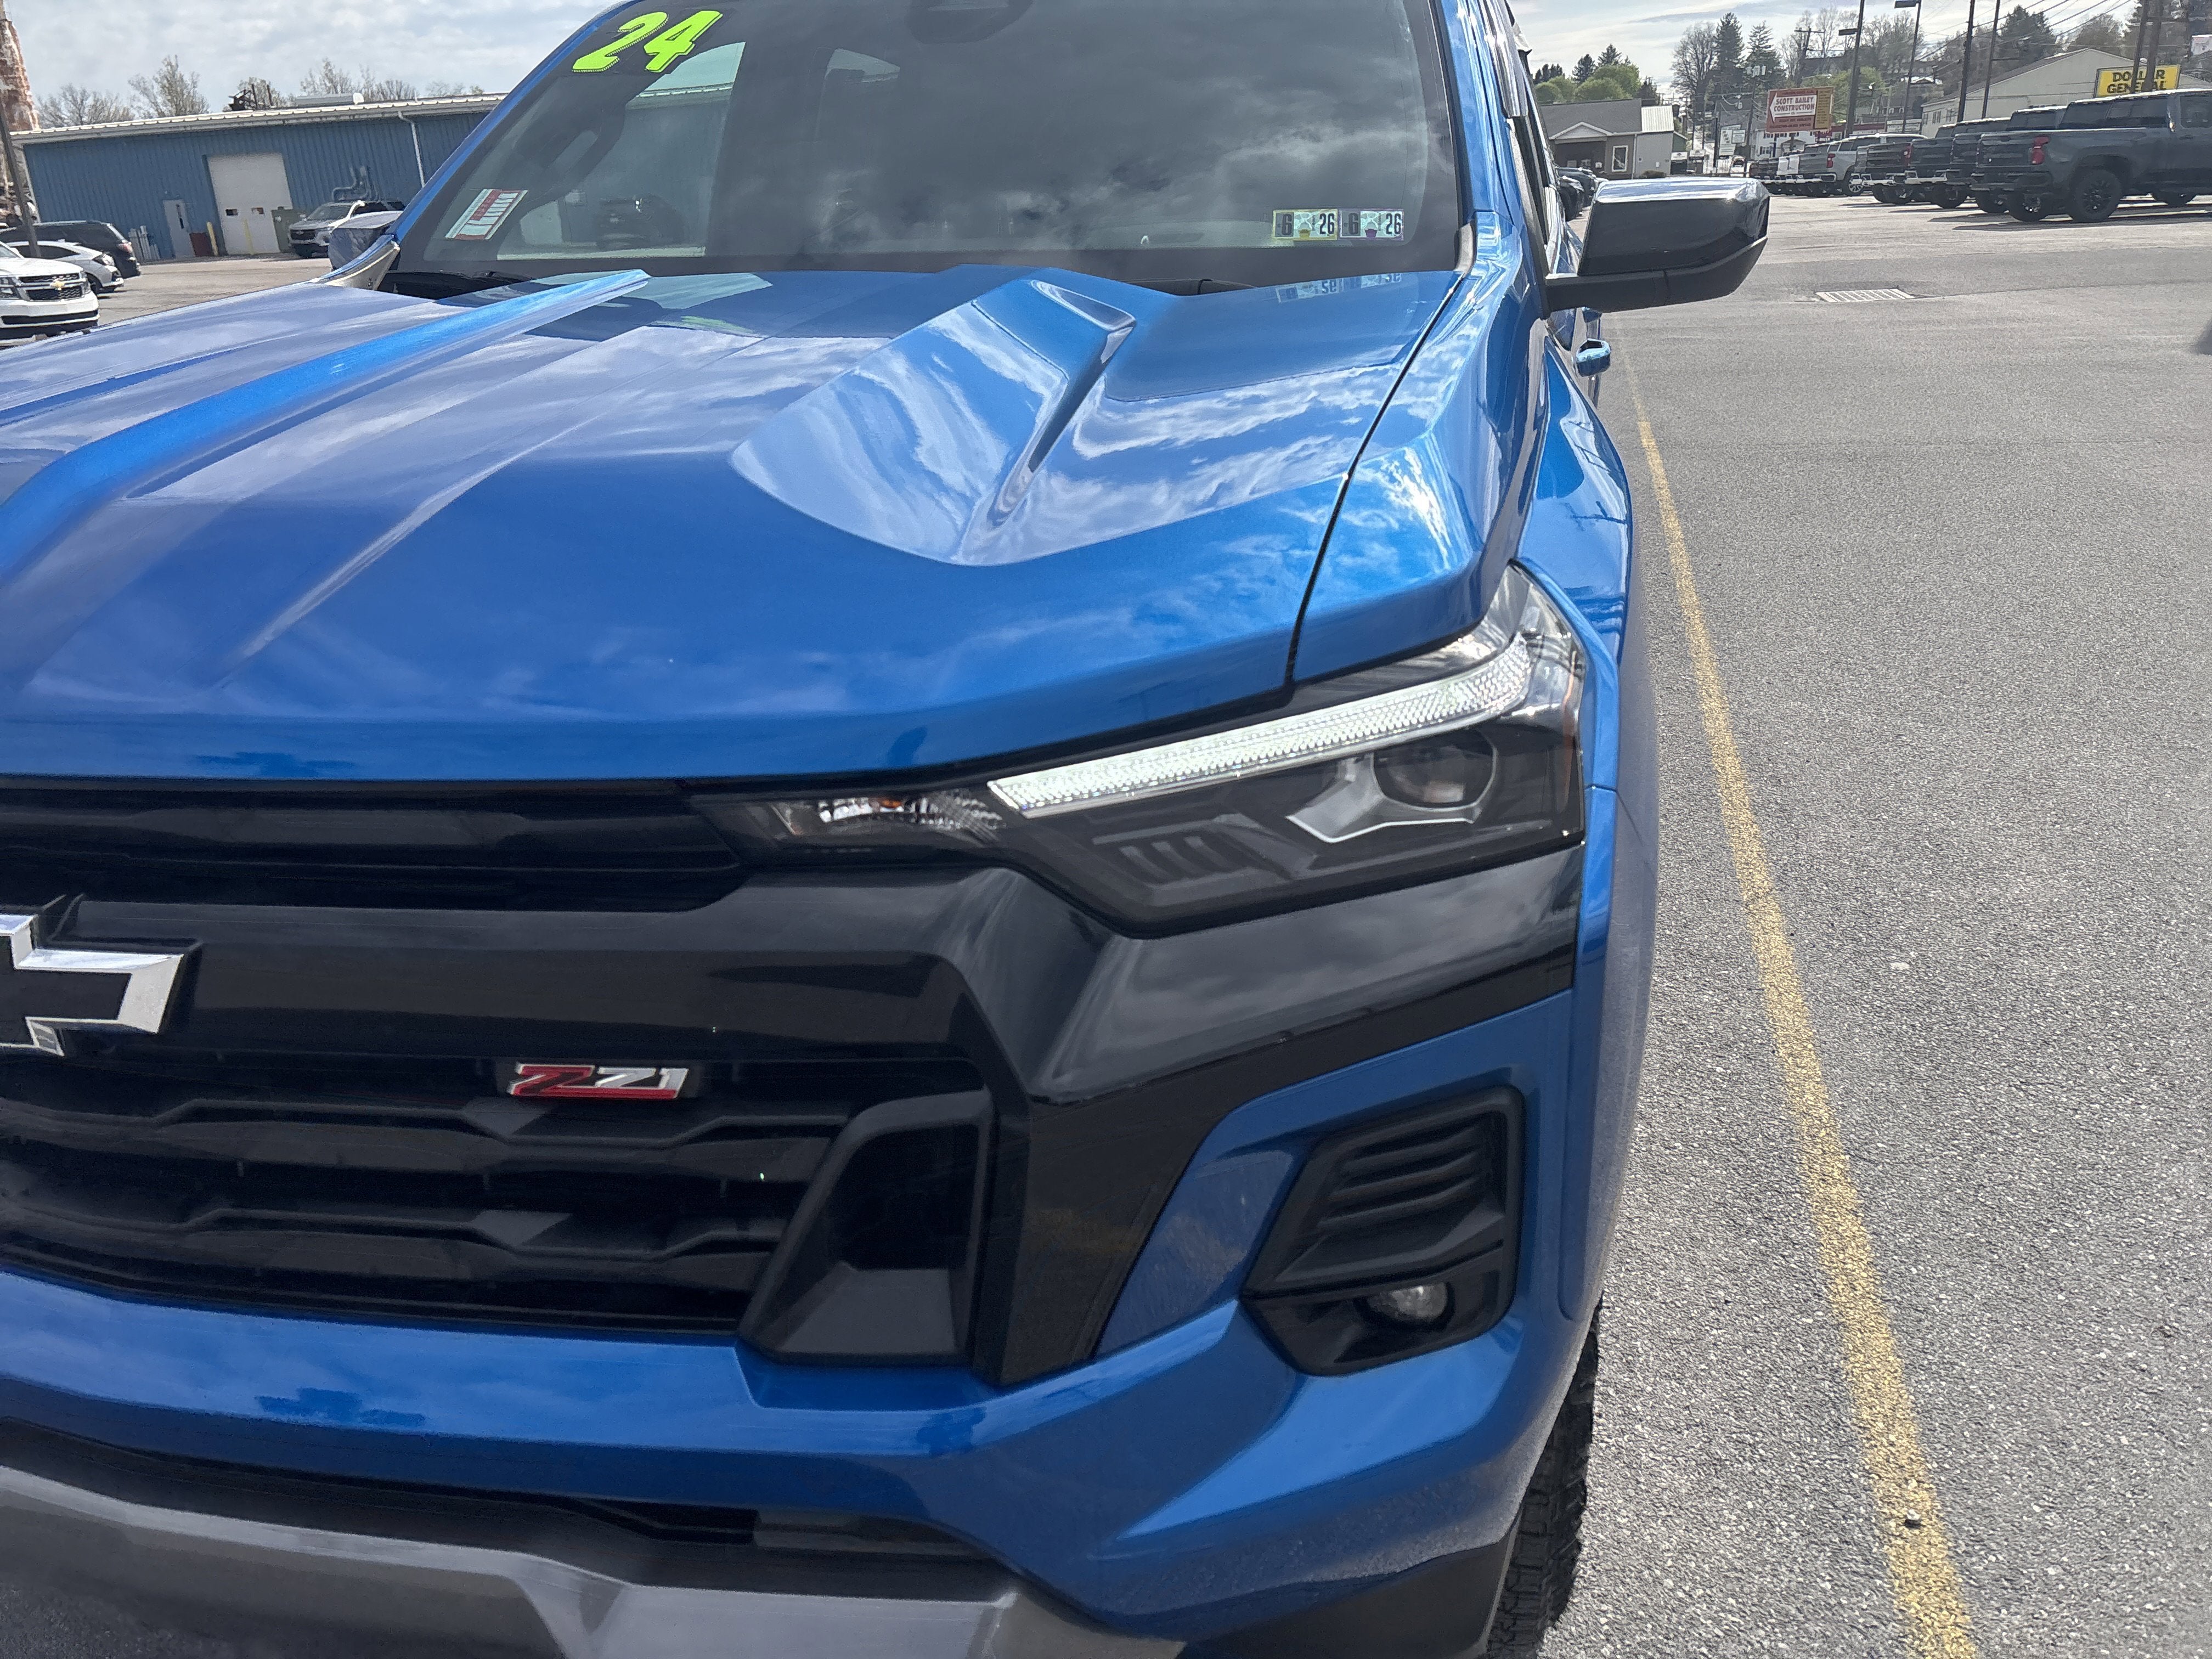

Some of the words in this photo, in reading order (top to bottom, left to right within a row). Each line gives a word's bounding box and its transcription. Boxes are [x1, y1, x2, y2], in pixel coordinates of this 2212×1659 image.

[571, 10, 723, 73] 24
[2112, 69, 2165, 82] DOLR
[1774, 103, 1815, 112] CONSTRUCTION
[1282, 213, 1293, 235] 6
[1319, 213, 1335, 235] 26
[1348, 213, 1359, 235] 6
[1386, 213, 1401, 235] 26
[507, 1062, 689, 1099] Z71
